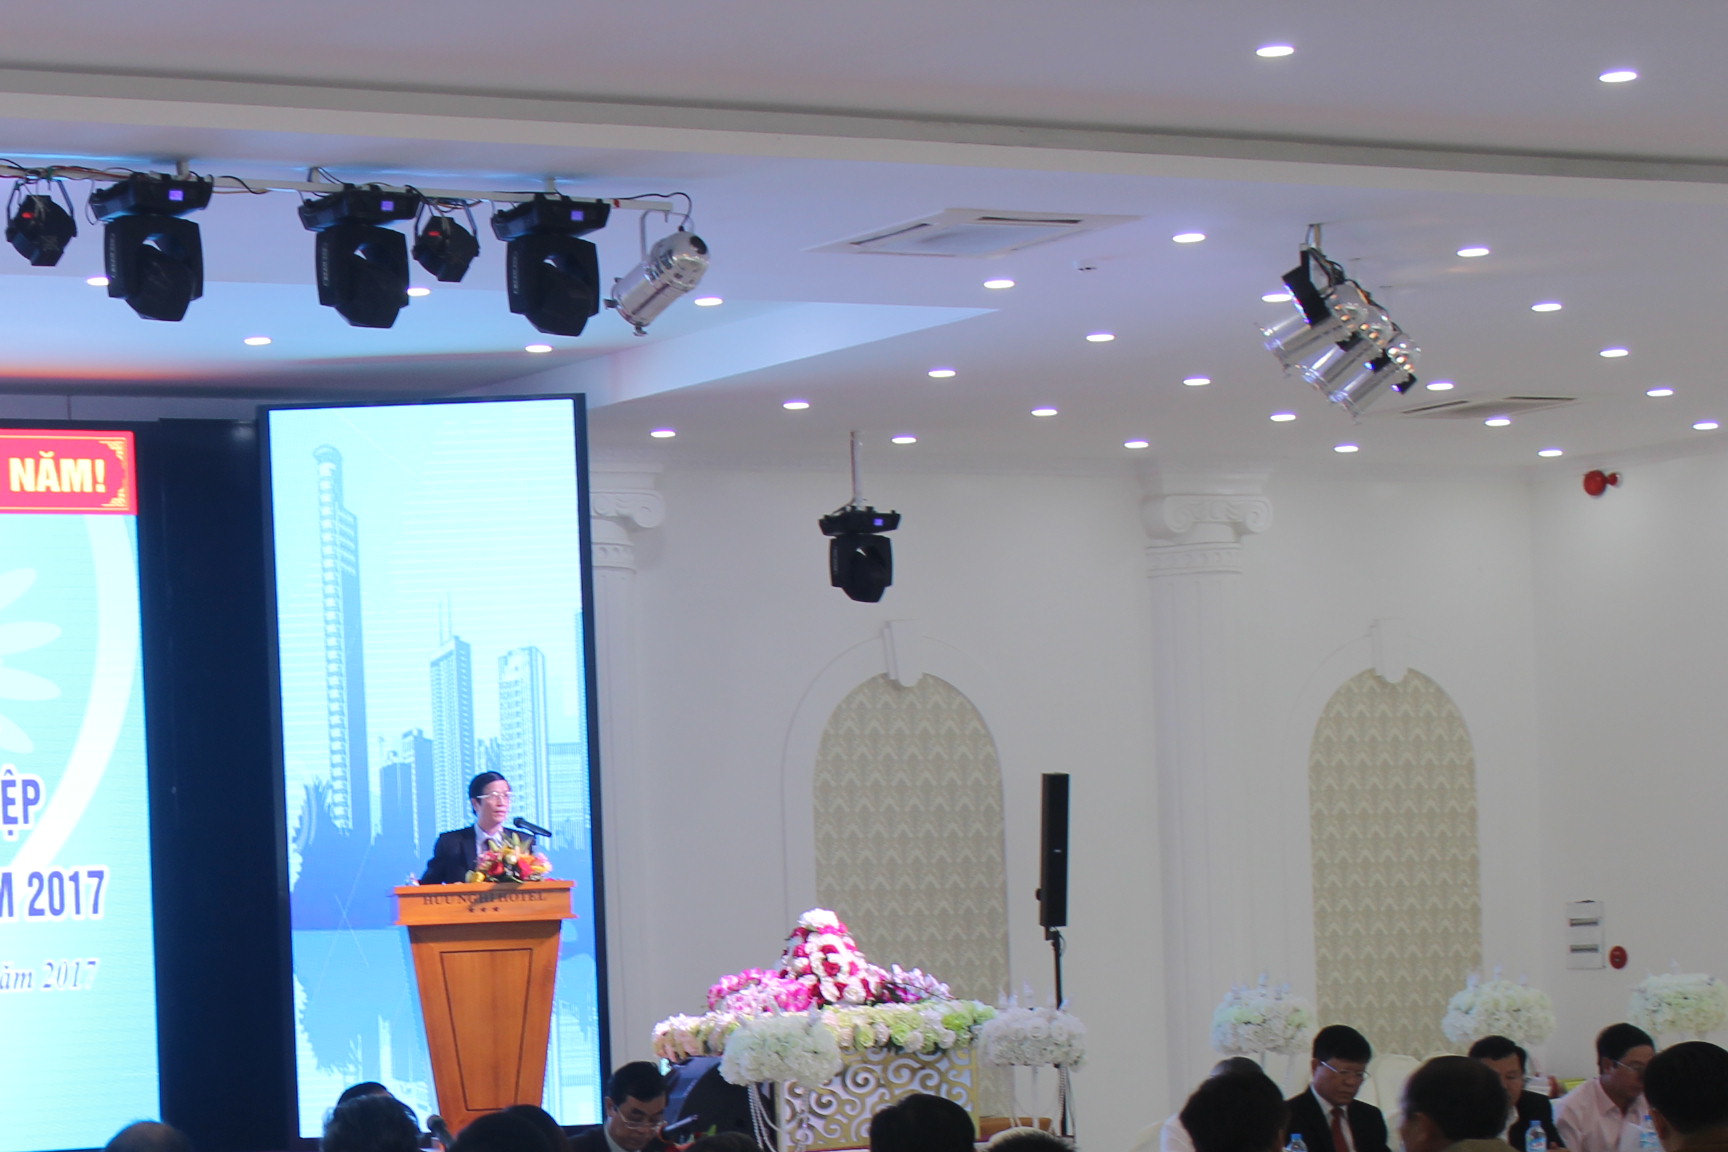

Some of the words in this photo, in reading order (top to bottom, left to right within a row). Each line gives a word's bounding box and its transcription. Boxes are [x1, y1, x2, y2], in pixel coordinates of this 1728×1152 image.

[9, 452, 106, 492] NĂM!
[28, 870, 104, 916] 2017
[41, 959, 97, 990] 2017
